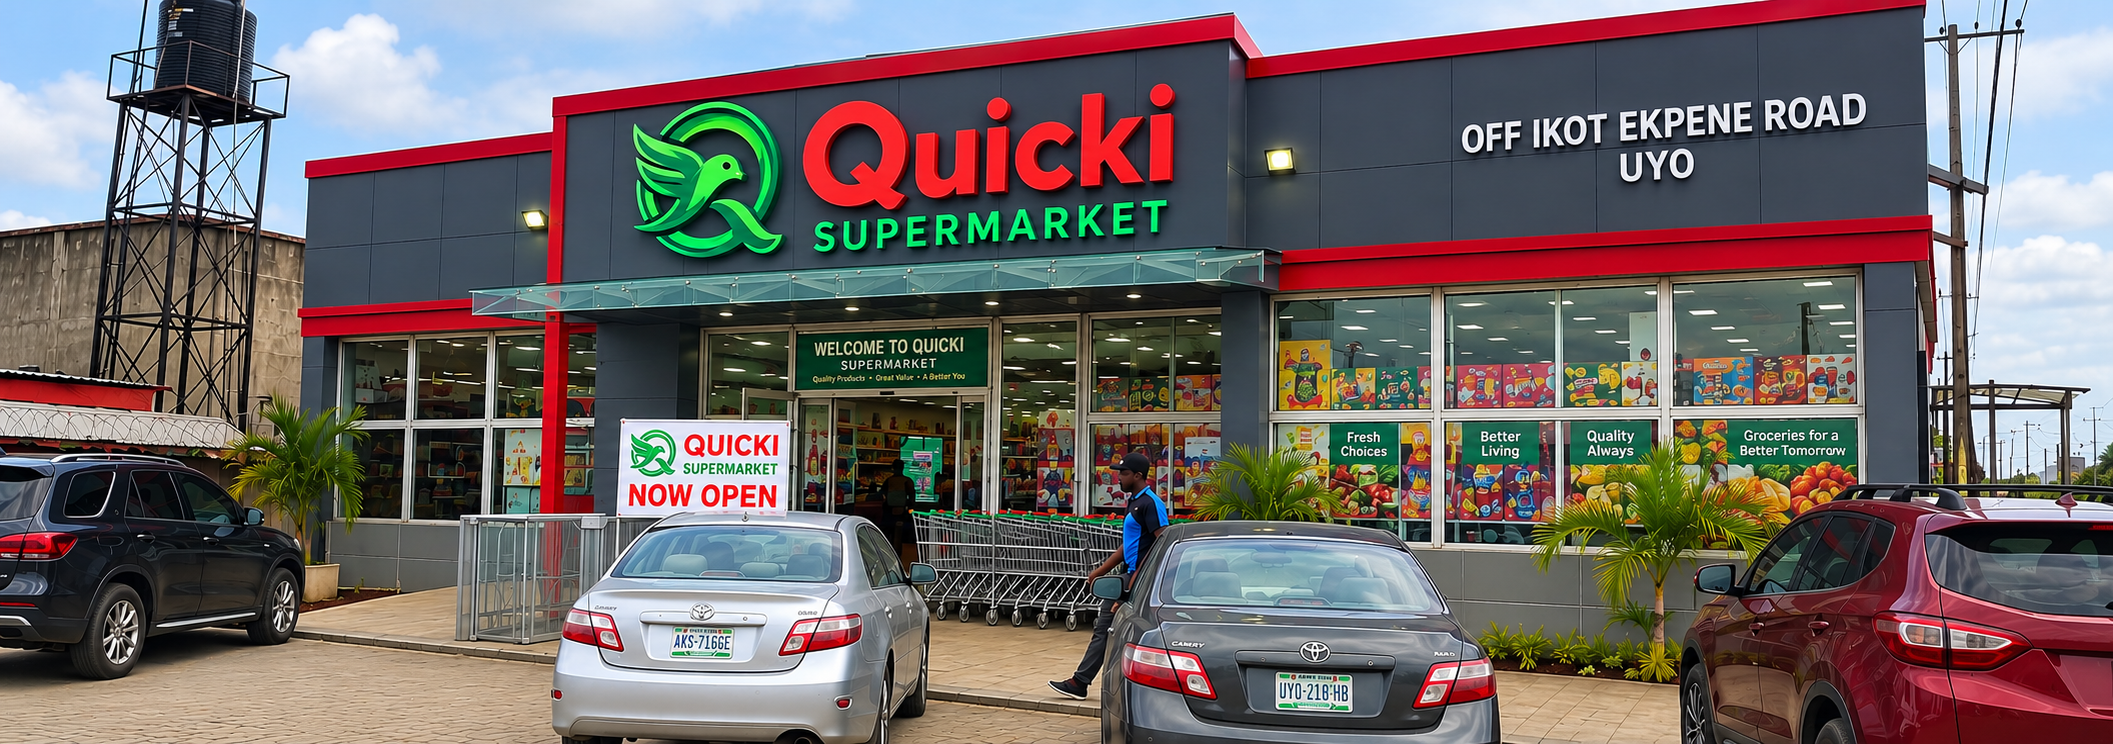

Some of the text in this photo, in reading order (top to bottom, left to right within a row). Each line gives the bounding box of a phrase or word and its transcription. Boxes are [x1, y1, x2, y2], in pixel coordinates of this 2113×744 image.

[1461, 93, 1867, 154] OFF IKOT EKPENE ROAD
[802, 83, 1176, 210] Quicki
[1619, 149, 1695, 182] UYO
[813, 199, 1168, 253] SUPERMARKET
[814, 336, 965, 357] WELCOME TO QUICKI
[840, 357, 937, 371] SUPERMARKET
[812, 375, 836, 384] Quality
[875, 374, 895, 382] Great
[928, 373, 951, 381] Better
[952, 372, 966, 380] You
[1347, 431, 1381, 443] Fresh
[1480, 431, 1522, 443] Better
[1587, 429, 1635, 444] Quality
[1743, 429, 1839, 442] Groceries for a
[684, 434, 779, 457] QUICKI
[1340, 445, 1388, 457] Choices
[1481, 445, 1520, 460] Living
[1587, 444, 1634, 458] Always
[1740, 444, 1846, 456] Better Tomorrow
[683, 462, 778, 475] SUPERMARKET
[628, 484, 777, 508] NOW OPEN
